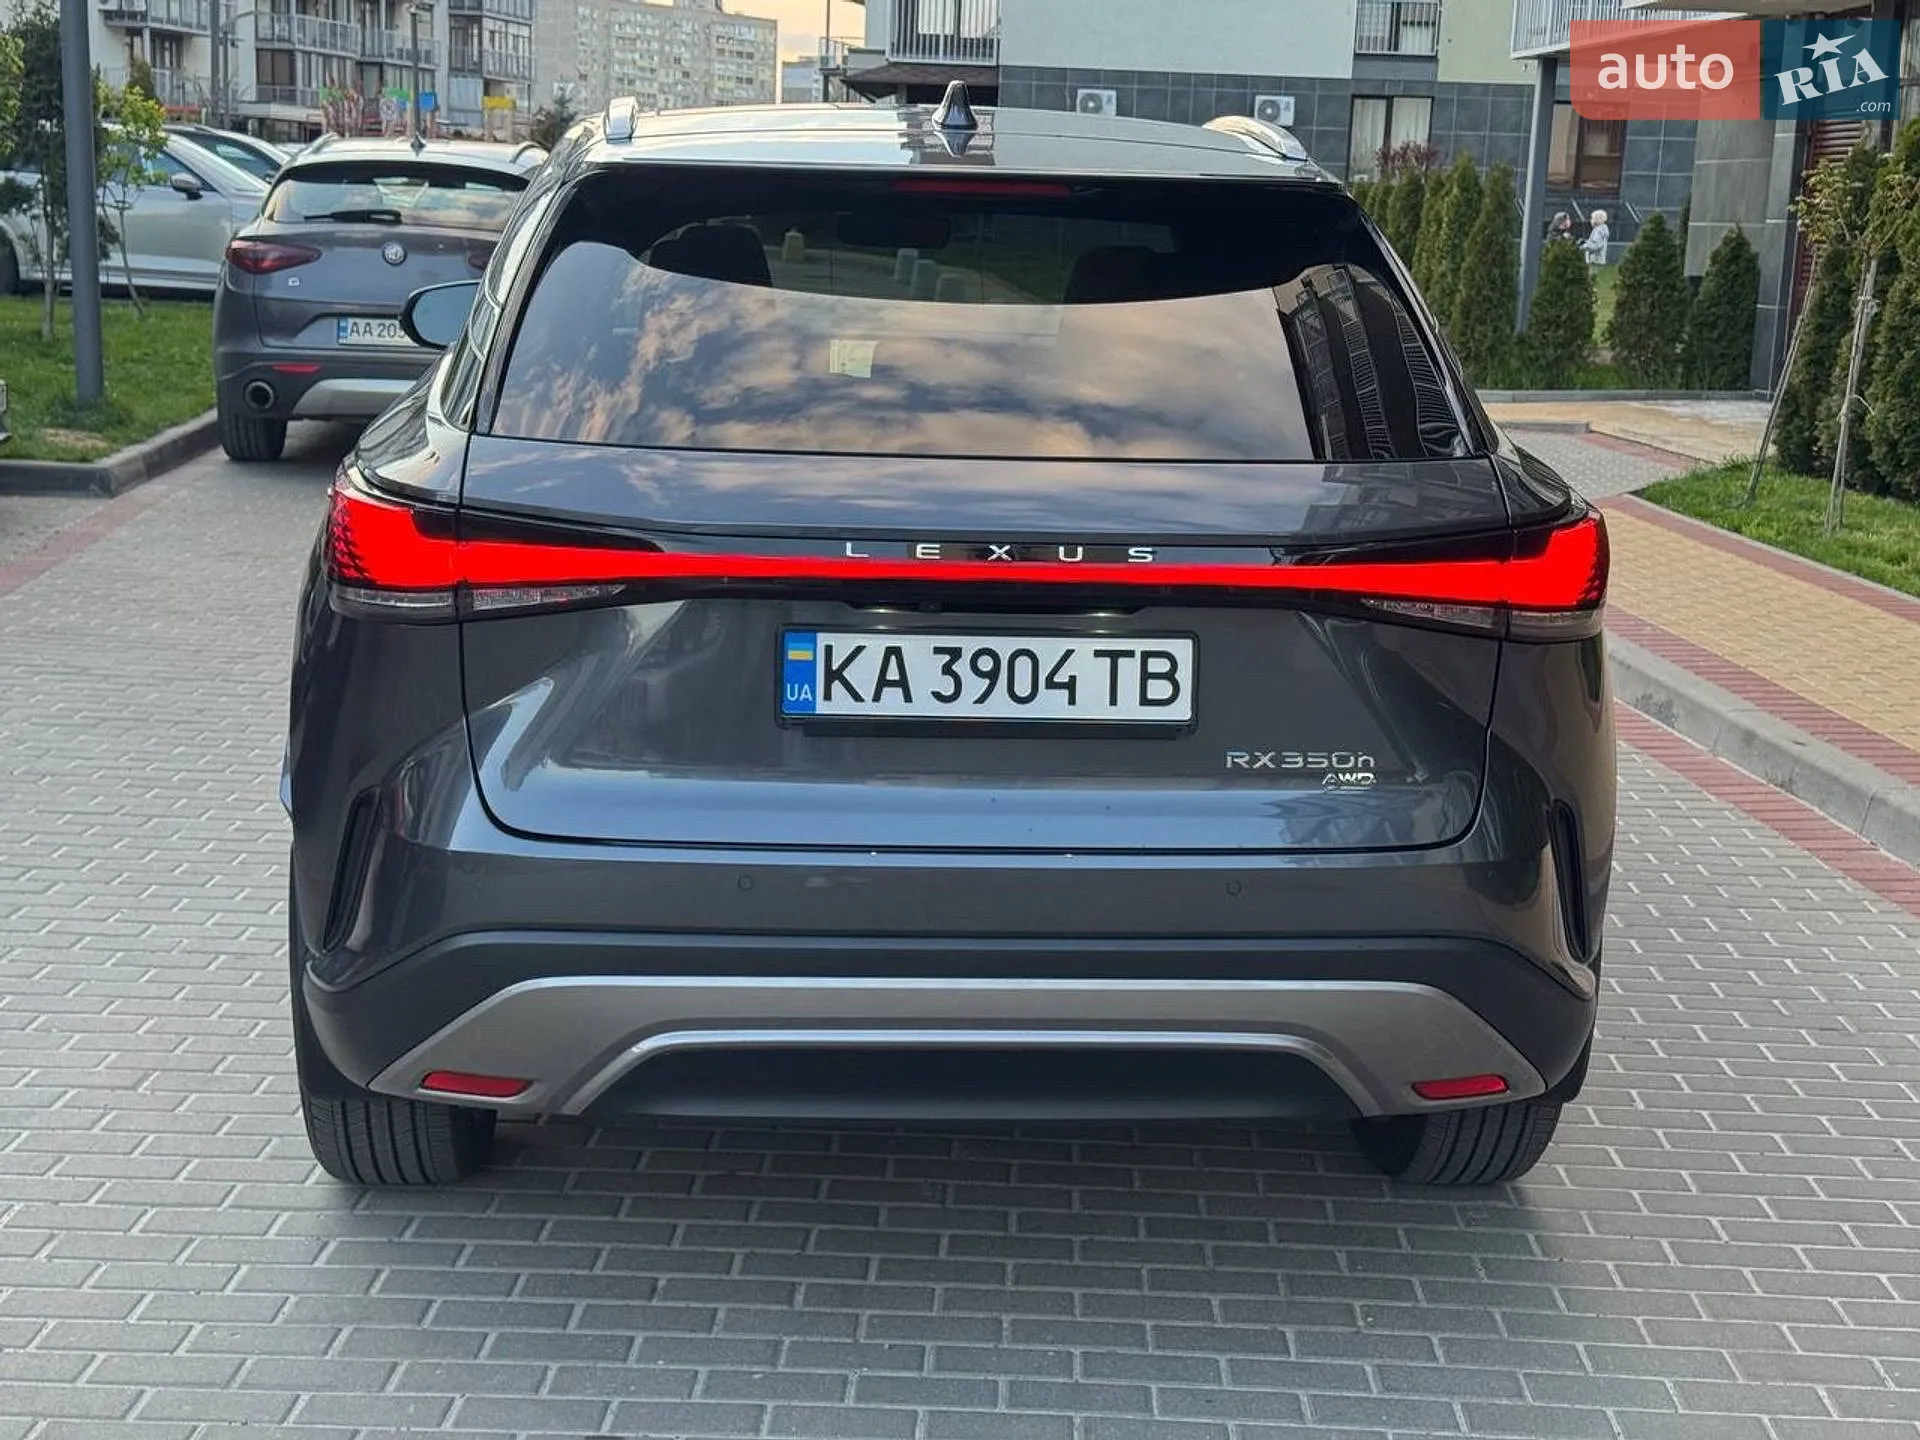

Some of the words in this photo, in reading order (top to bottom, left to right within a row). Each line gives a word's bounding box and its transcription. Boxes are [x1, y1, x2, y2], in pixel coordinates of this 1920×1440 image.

[349, 321, 373, 338] AA
[845, 541, 1154, 562] LEXUS
[822, 644, 914, 704] KA
[930, 645, 1078, 706] 3904
[1093, 648, 1181, 707] TB
[786, 683, 813, 702] UA
[1321, 772, 1376, 785] AWD
